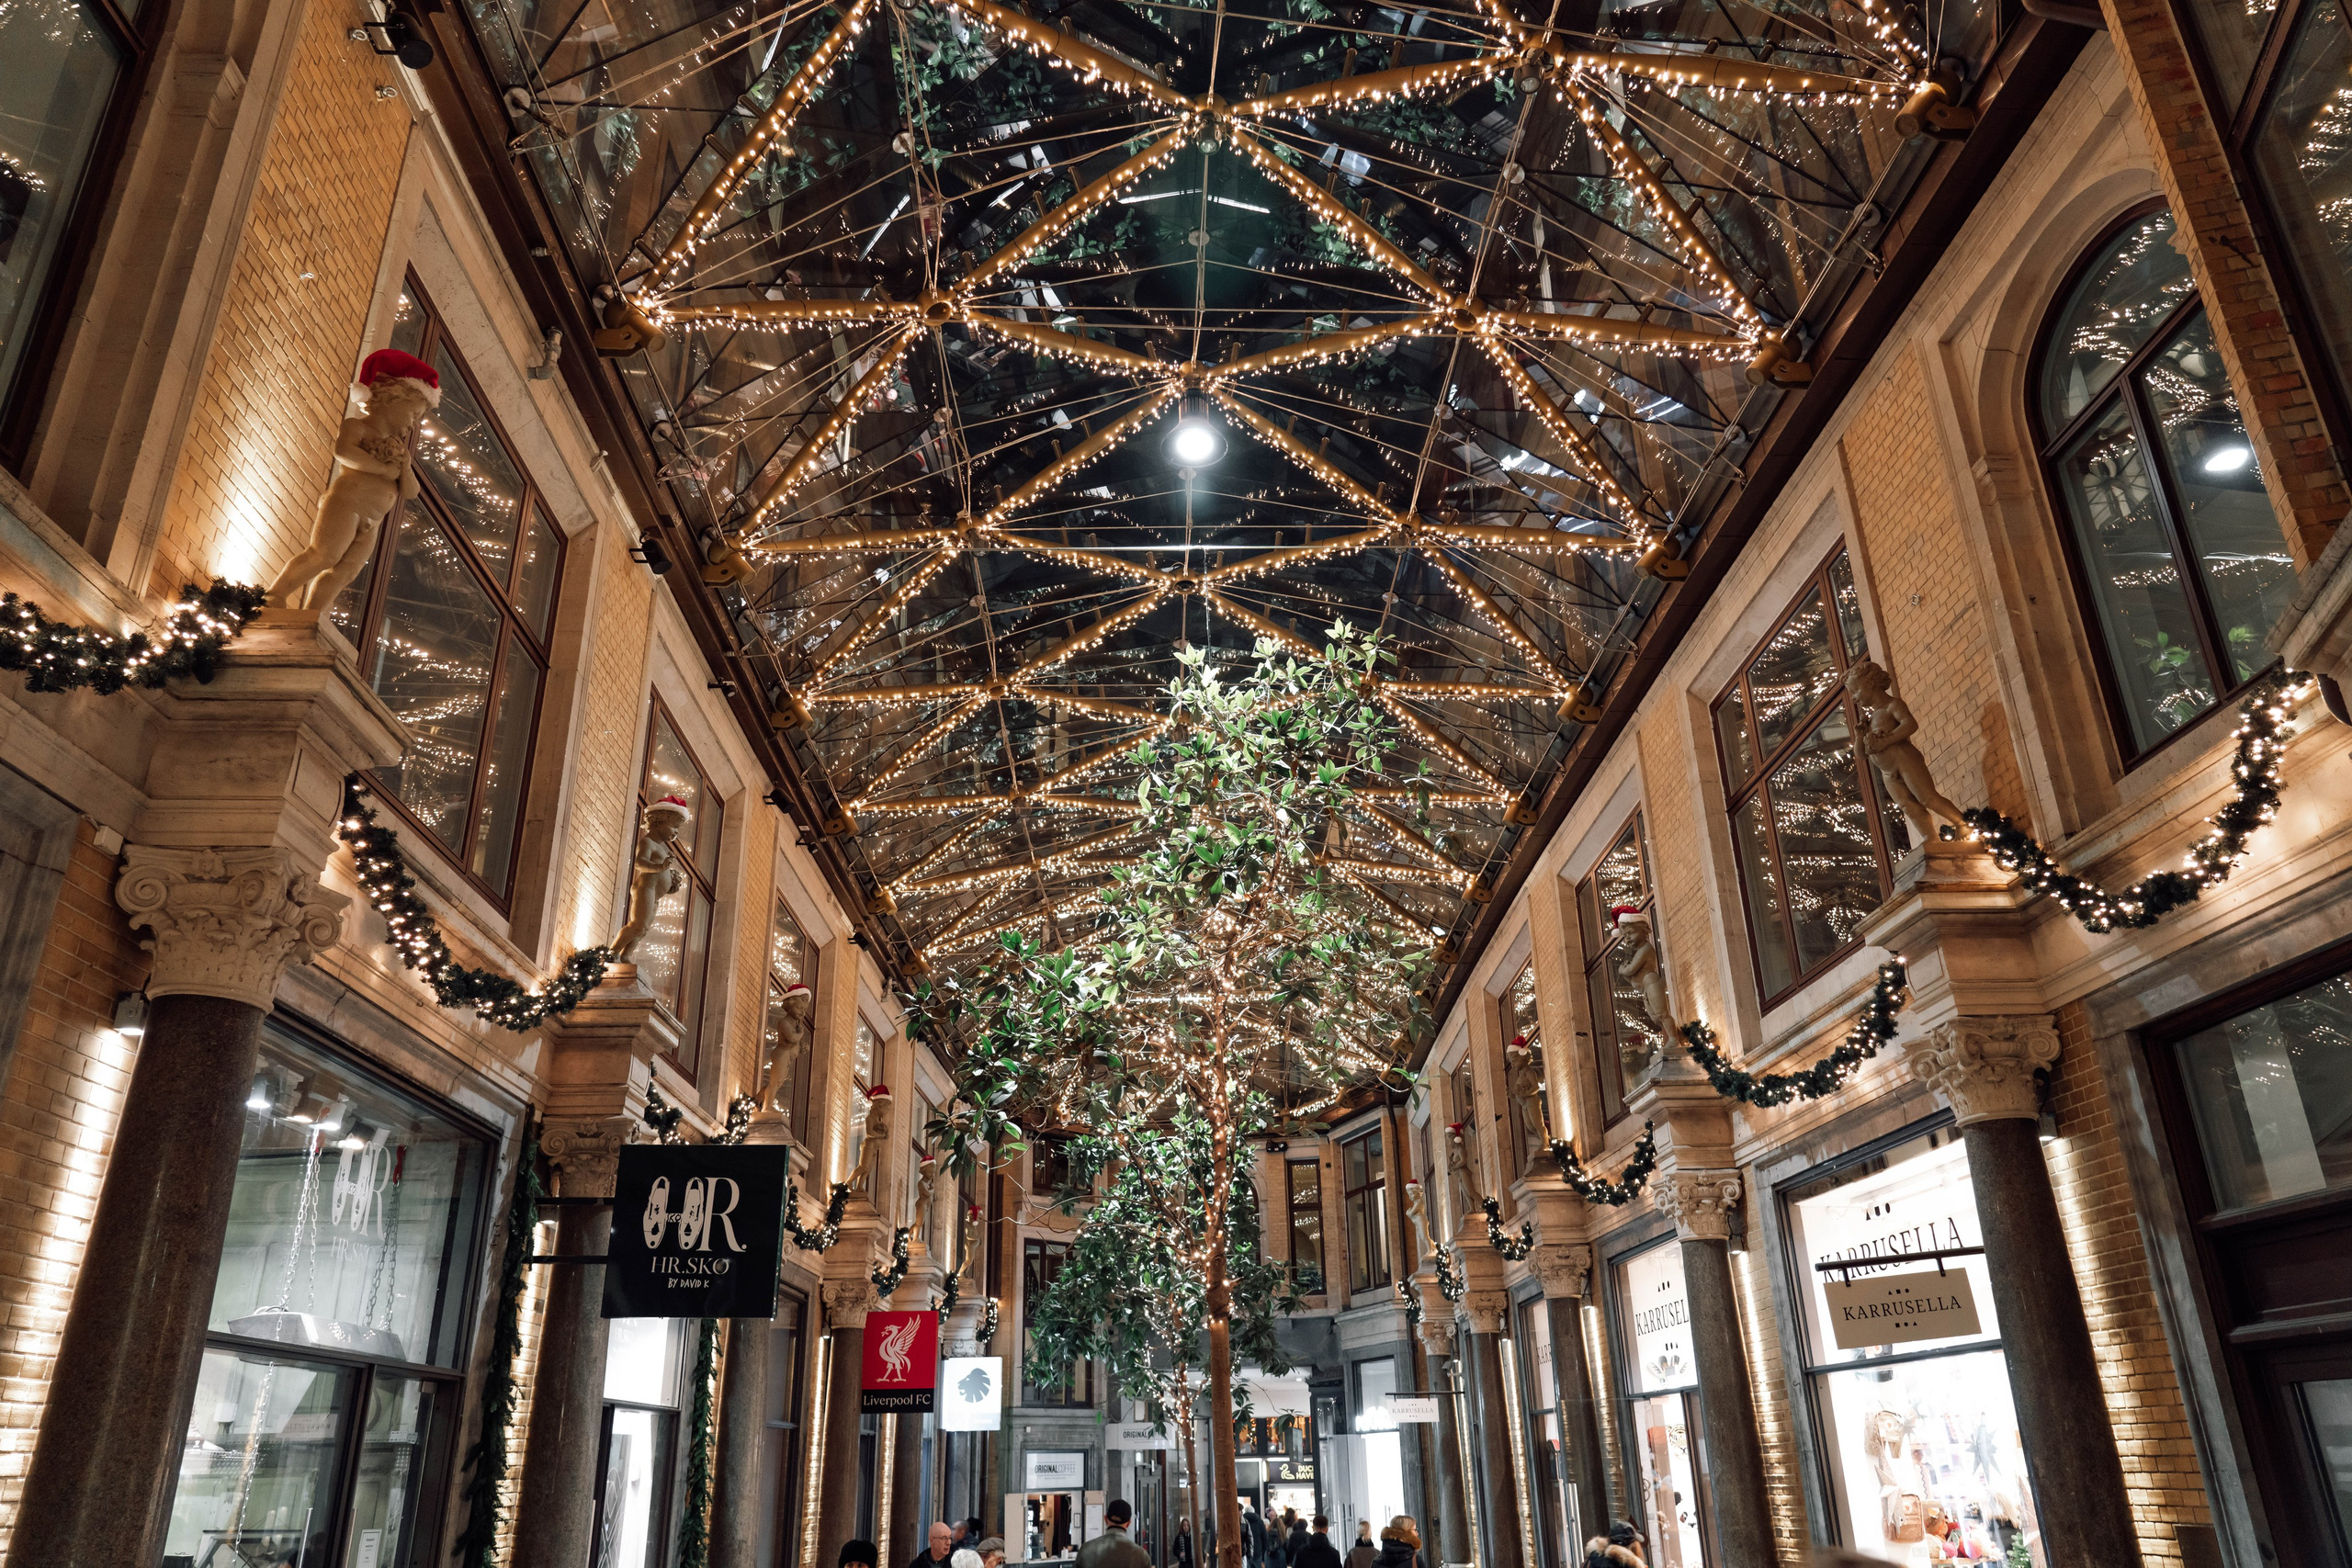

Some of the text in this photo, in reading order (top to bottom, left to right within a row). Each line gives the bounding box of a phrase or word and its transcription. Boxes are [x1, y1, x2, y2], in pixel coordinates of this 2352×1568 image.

[1819, 1216, 1964, 1284] KARRUSELLA
[650, 1256, 730, 1276] HR.SKO
[668, 1277, 710, 1289] BY DAVID K
[1842, 1295, 1962, 1321] KARRUSELLA
[863, 1393, 932, 1408] Liverpool FC
